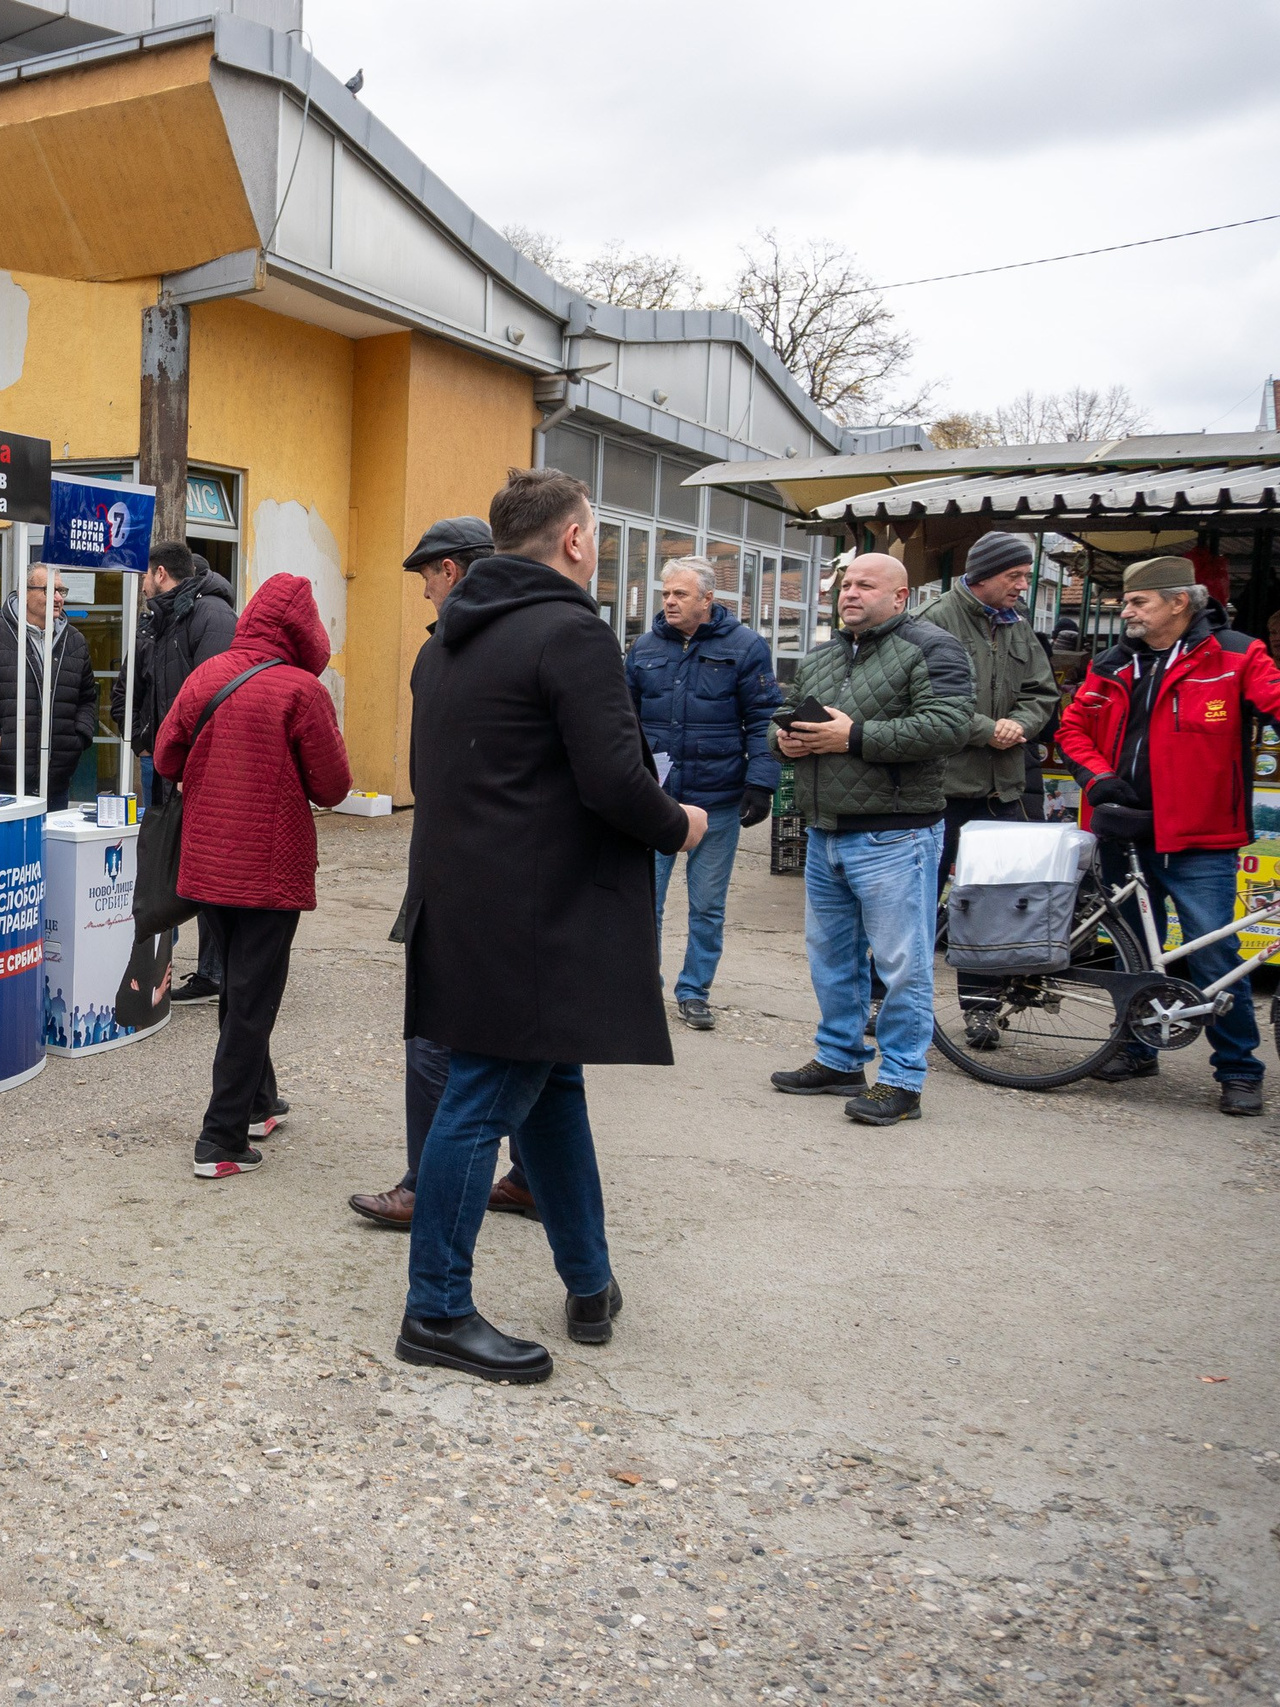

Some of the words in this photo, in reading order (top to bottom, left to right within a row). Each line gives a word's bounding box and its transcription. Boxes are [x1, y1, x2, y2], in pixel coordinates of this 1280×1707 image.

[186, 481, 218, 515] WC
[71, 518, 105, 532] СРБИЈА
[70, 528, 104, 542] ПРОТИВ
[70, 540, 105, 553] НАСИЉА
[88, 885, 112, 899] НОВО
[114, 880, 134, 894] ЛИЦЕ
[94, 893, 129, 912] СРБИЈЕ
[6, 943, 43, 972] СРБИЈА
